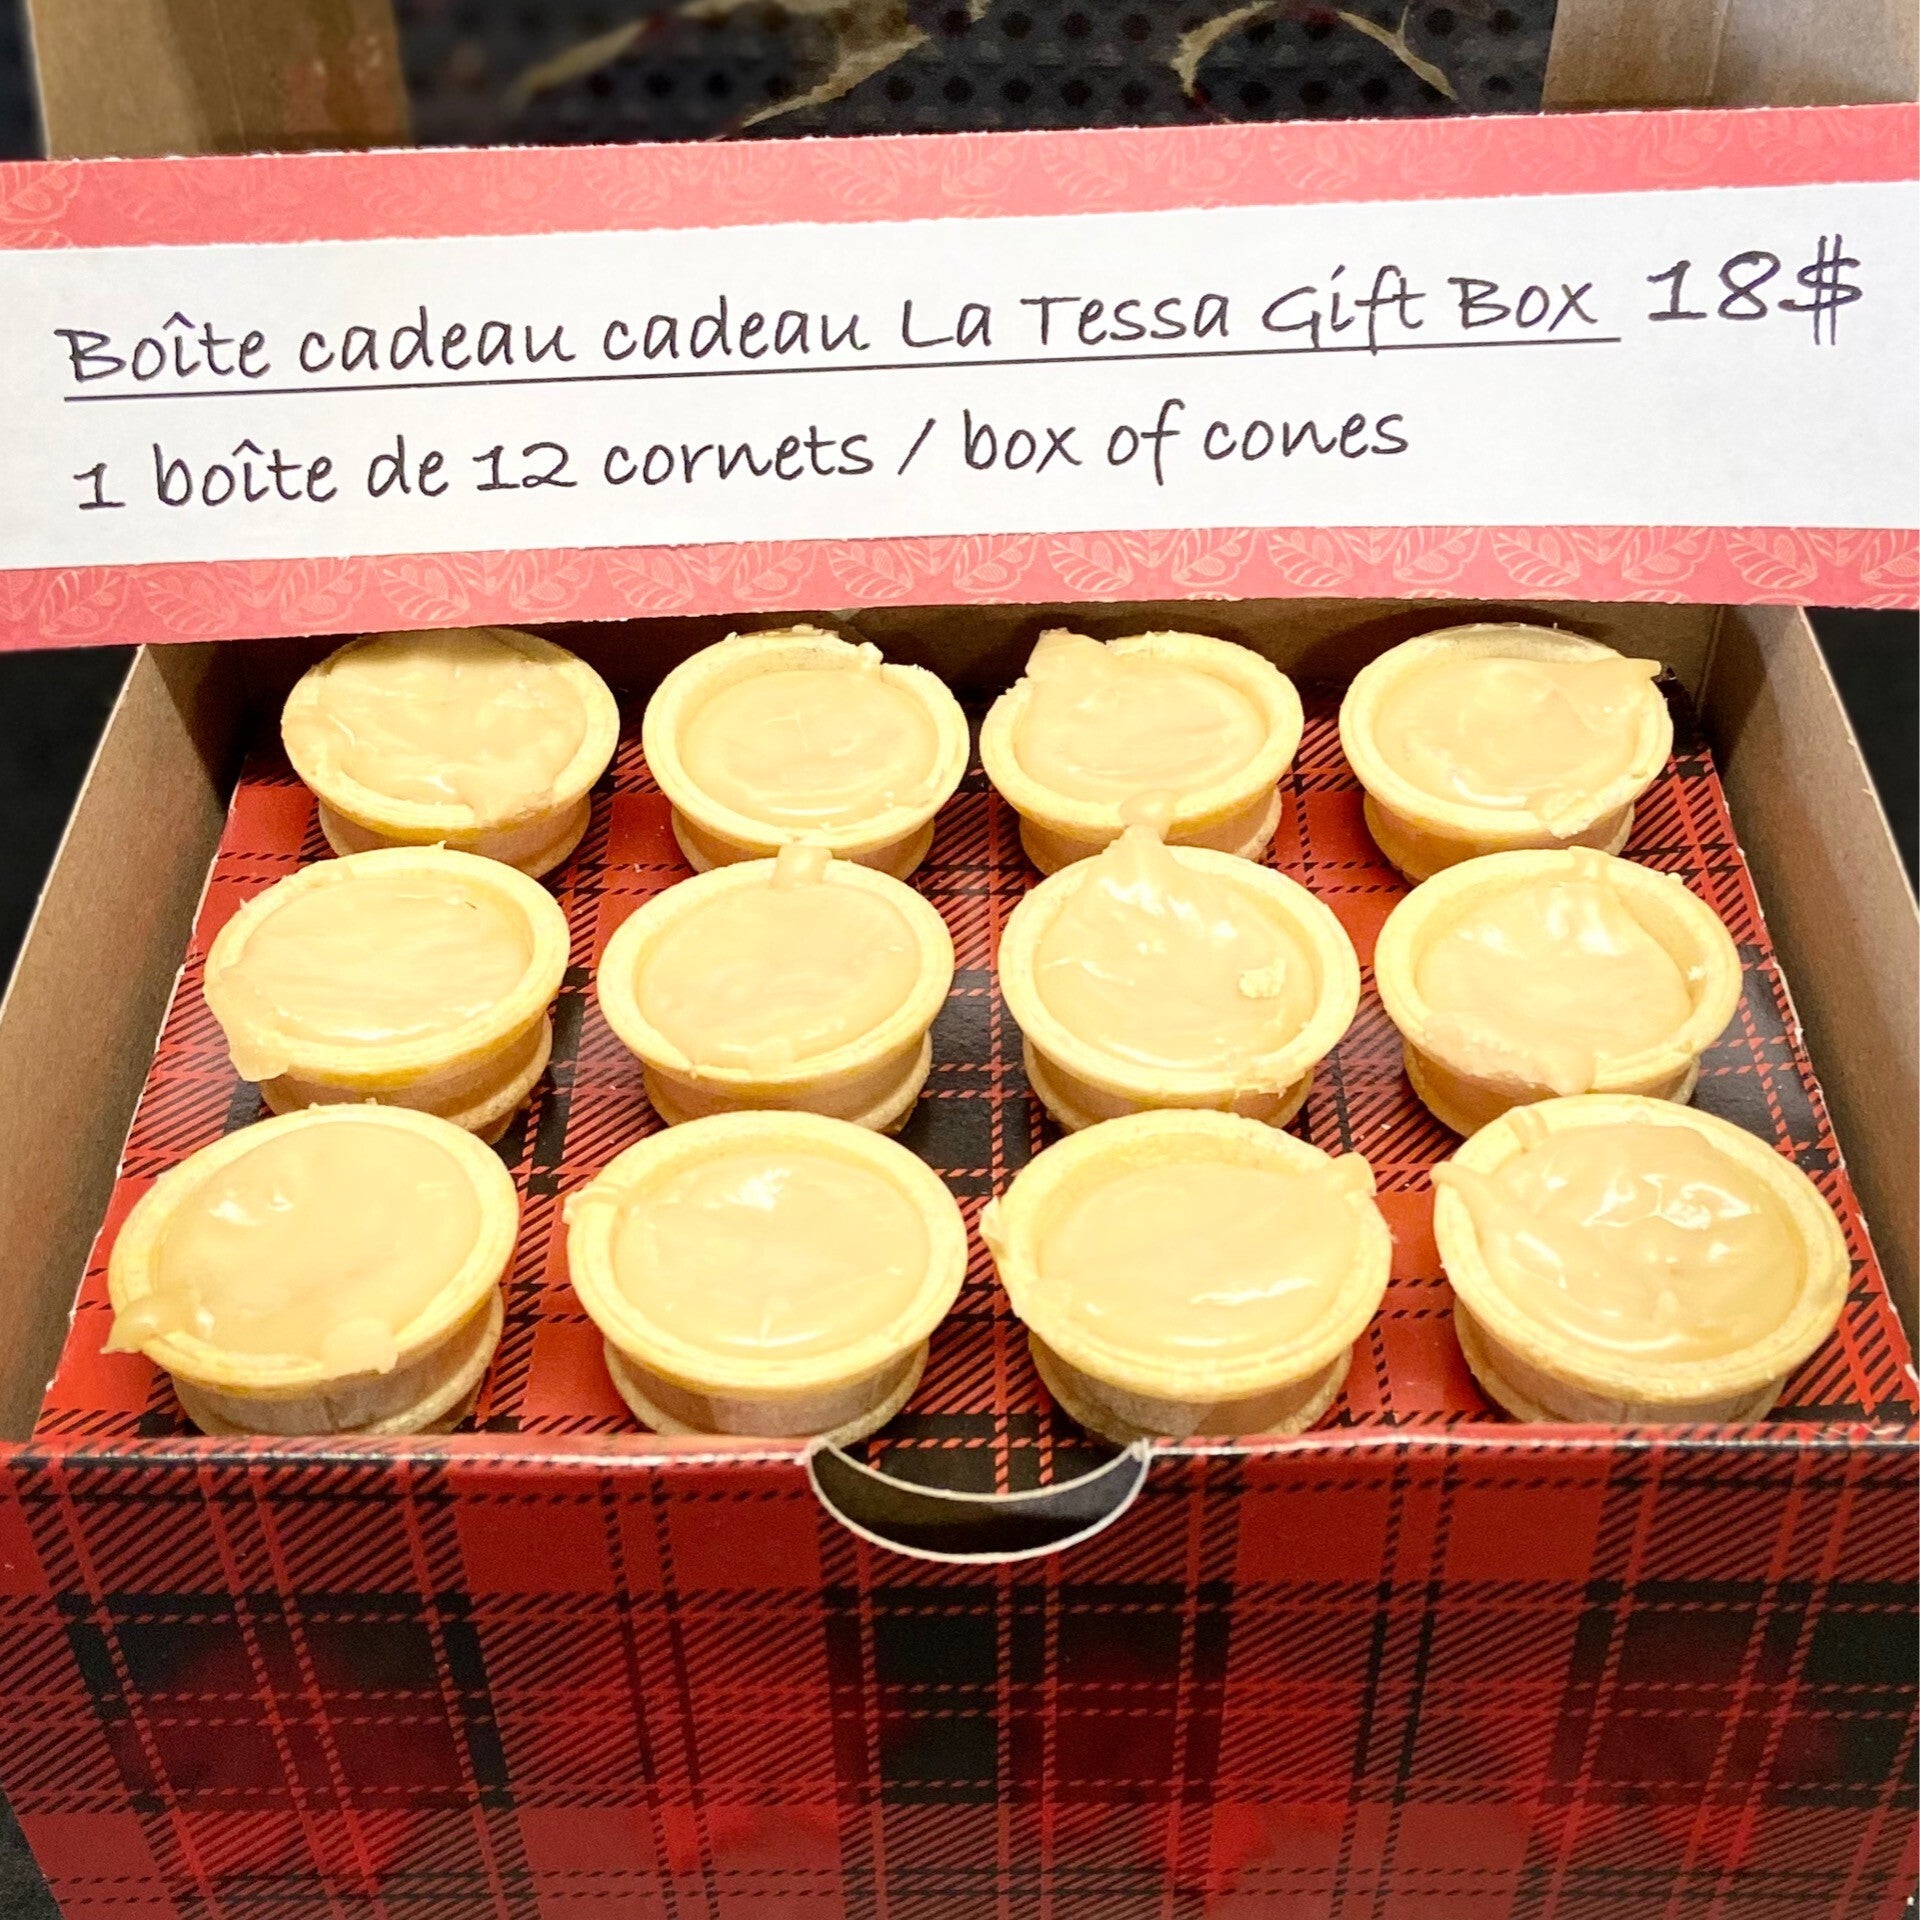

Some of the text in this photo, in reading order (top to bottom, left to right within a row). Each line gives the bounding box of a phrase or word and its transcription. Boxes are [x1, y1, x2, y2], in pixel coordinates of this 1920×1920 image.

[53, 233, 1863, 382] Boîte cadeau cadeau La Tessa Gift Box 18$
[73, 398, 1409, 510] 1 boîte de 12 cornets / box of cones
